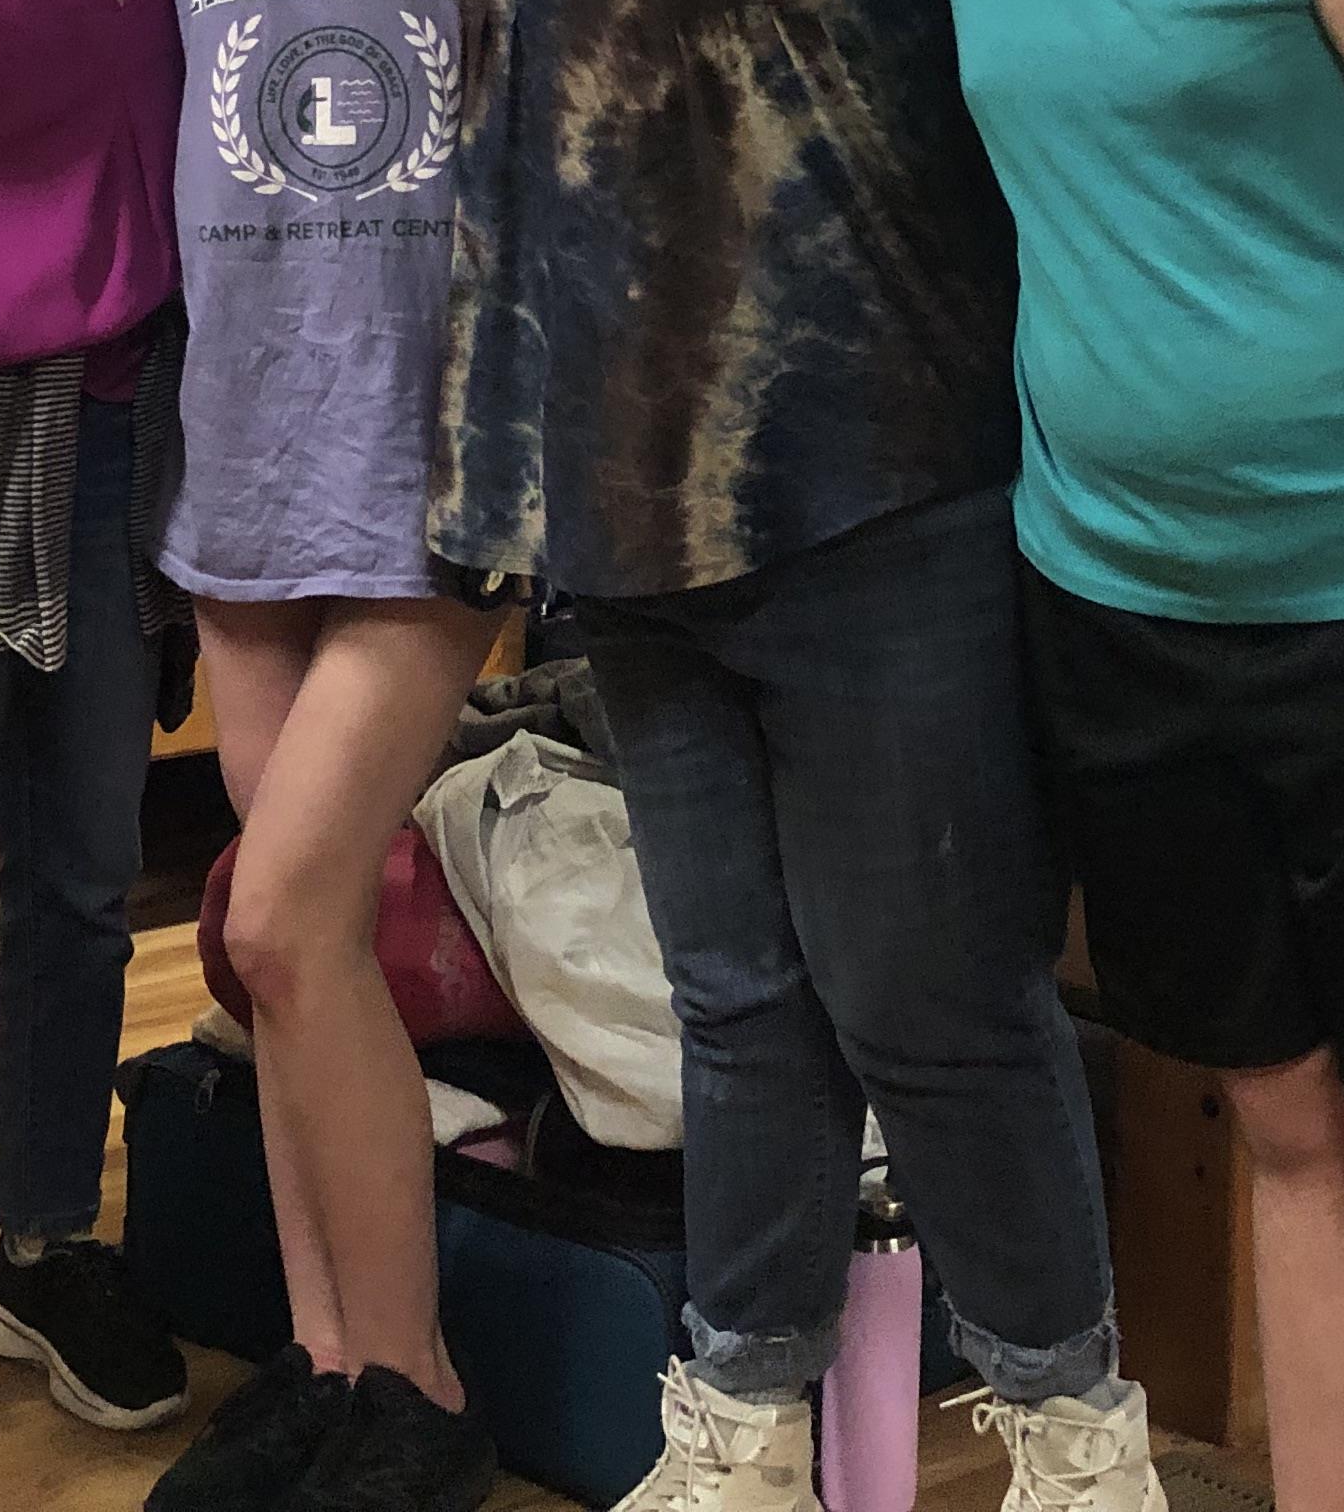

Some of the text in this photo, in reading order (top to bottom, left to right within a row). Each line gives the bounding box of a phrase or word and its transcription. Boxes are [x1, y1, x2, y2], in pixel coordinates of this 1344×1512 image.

[315, 34, 336, 46] THE
[199, 218, 452, 243] CAMP & RETREAT CENT
